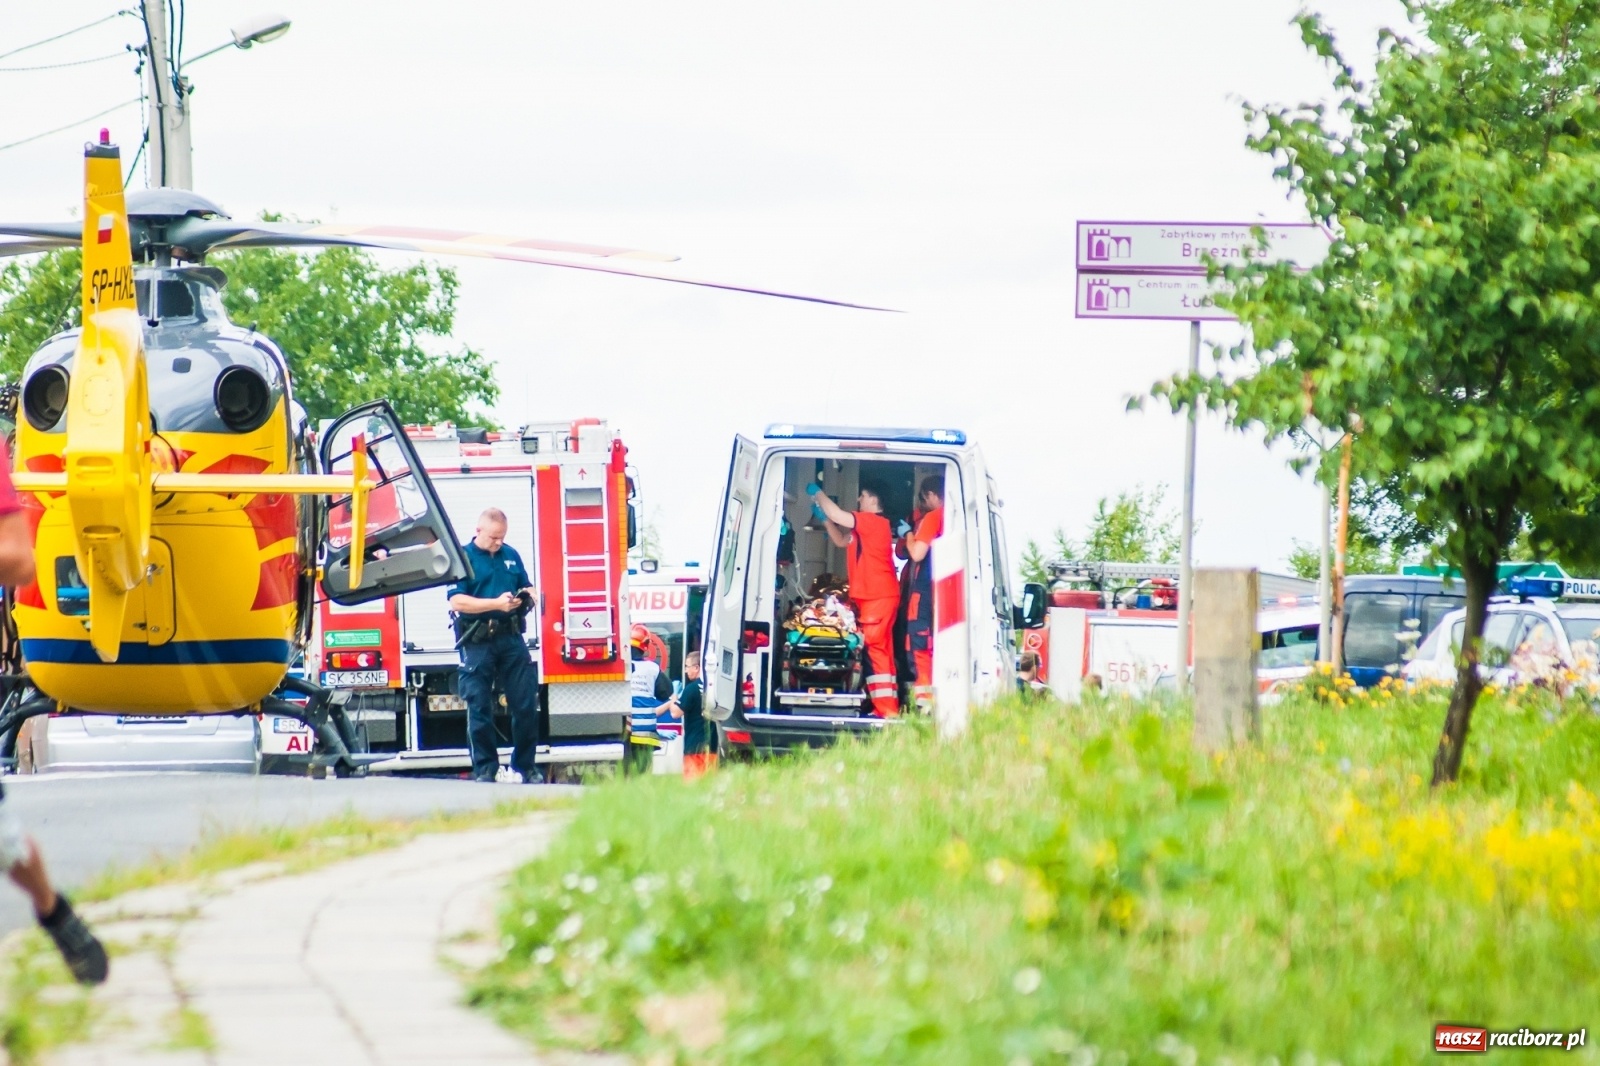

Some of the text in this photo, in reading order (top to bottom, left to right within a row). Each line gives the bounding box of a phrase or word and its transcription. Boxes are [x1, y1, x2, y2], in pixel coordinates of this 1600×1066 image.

[1160, 229, 1216, 241] Zabytkowy
[1221, 230, 1246, 241] młyn
[1137, 279, 1182, 289] Centrum
[350, 671, 386, 684] 356NE
